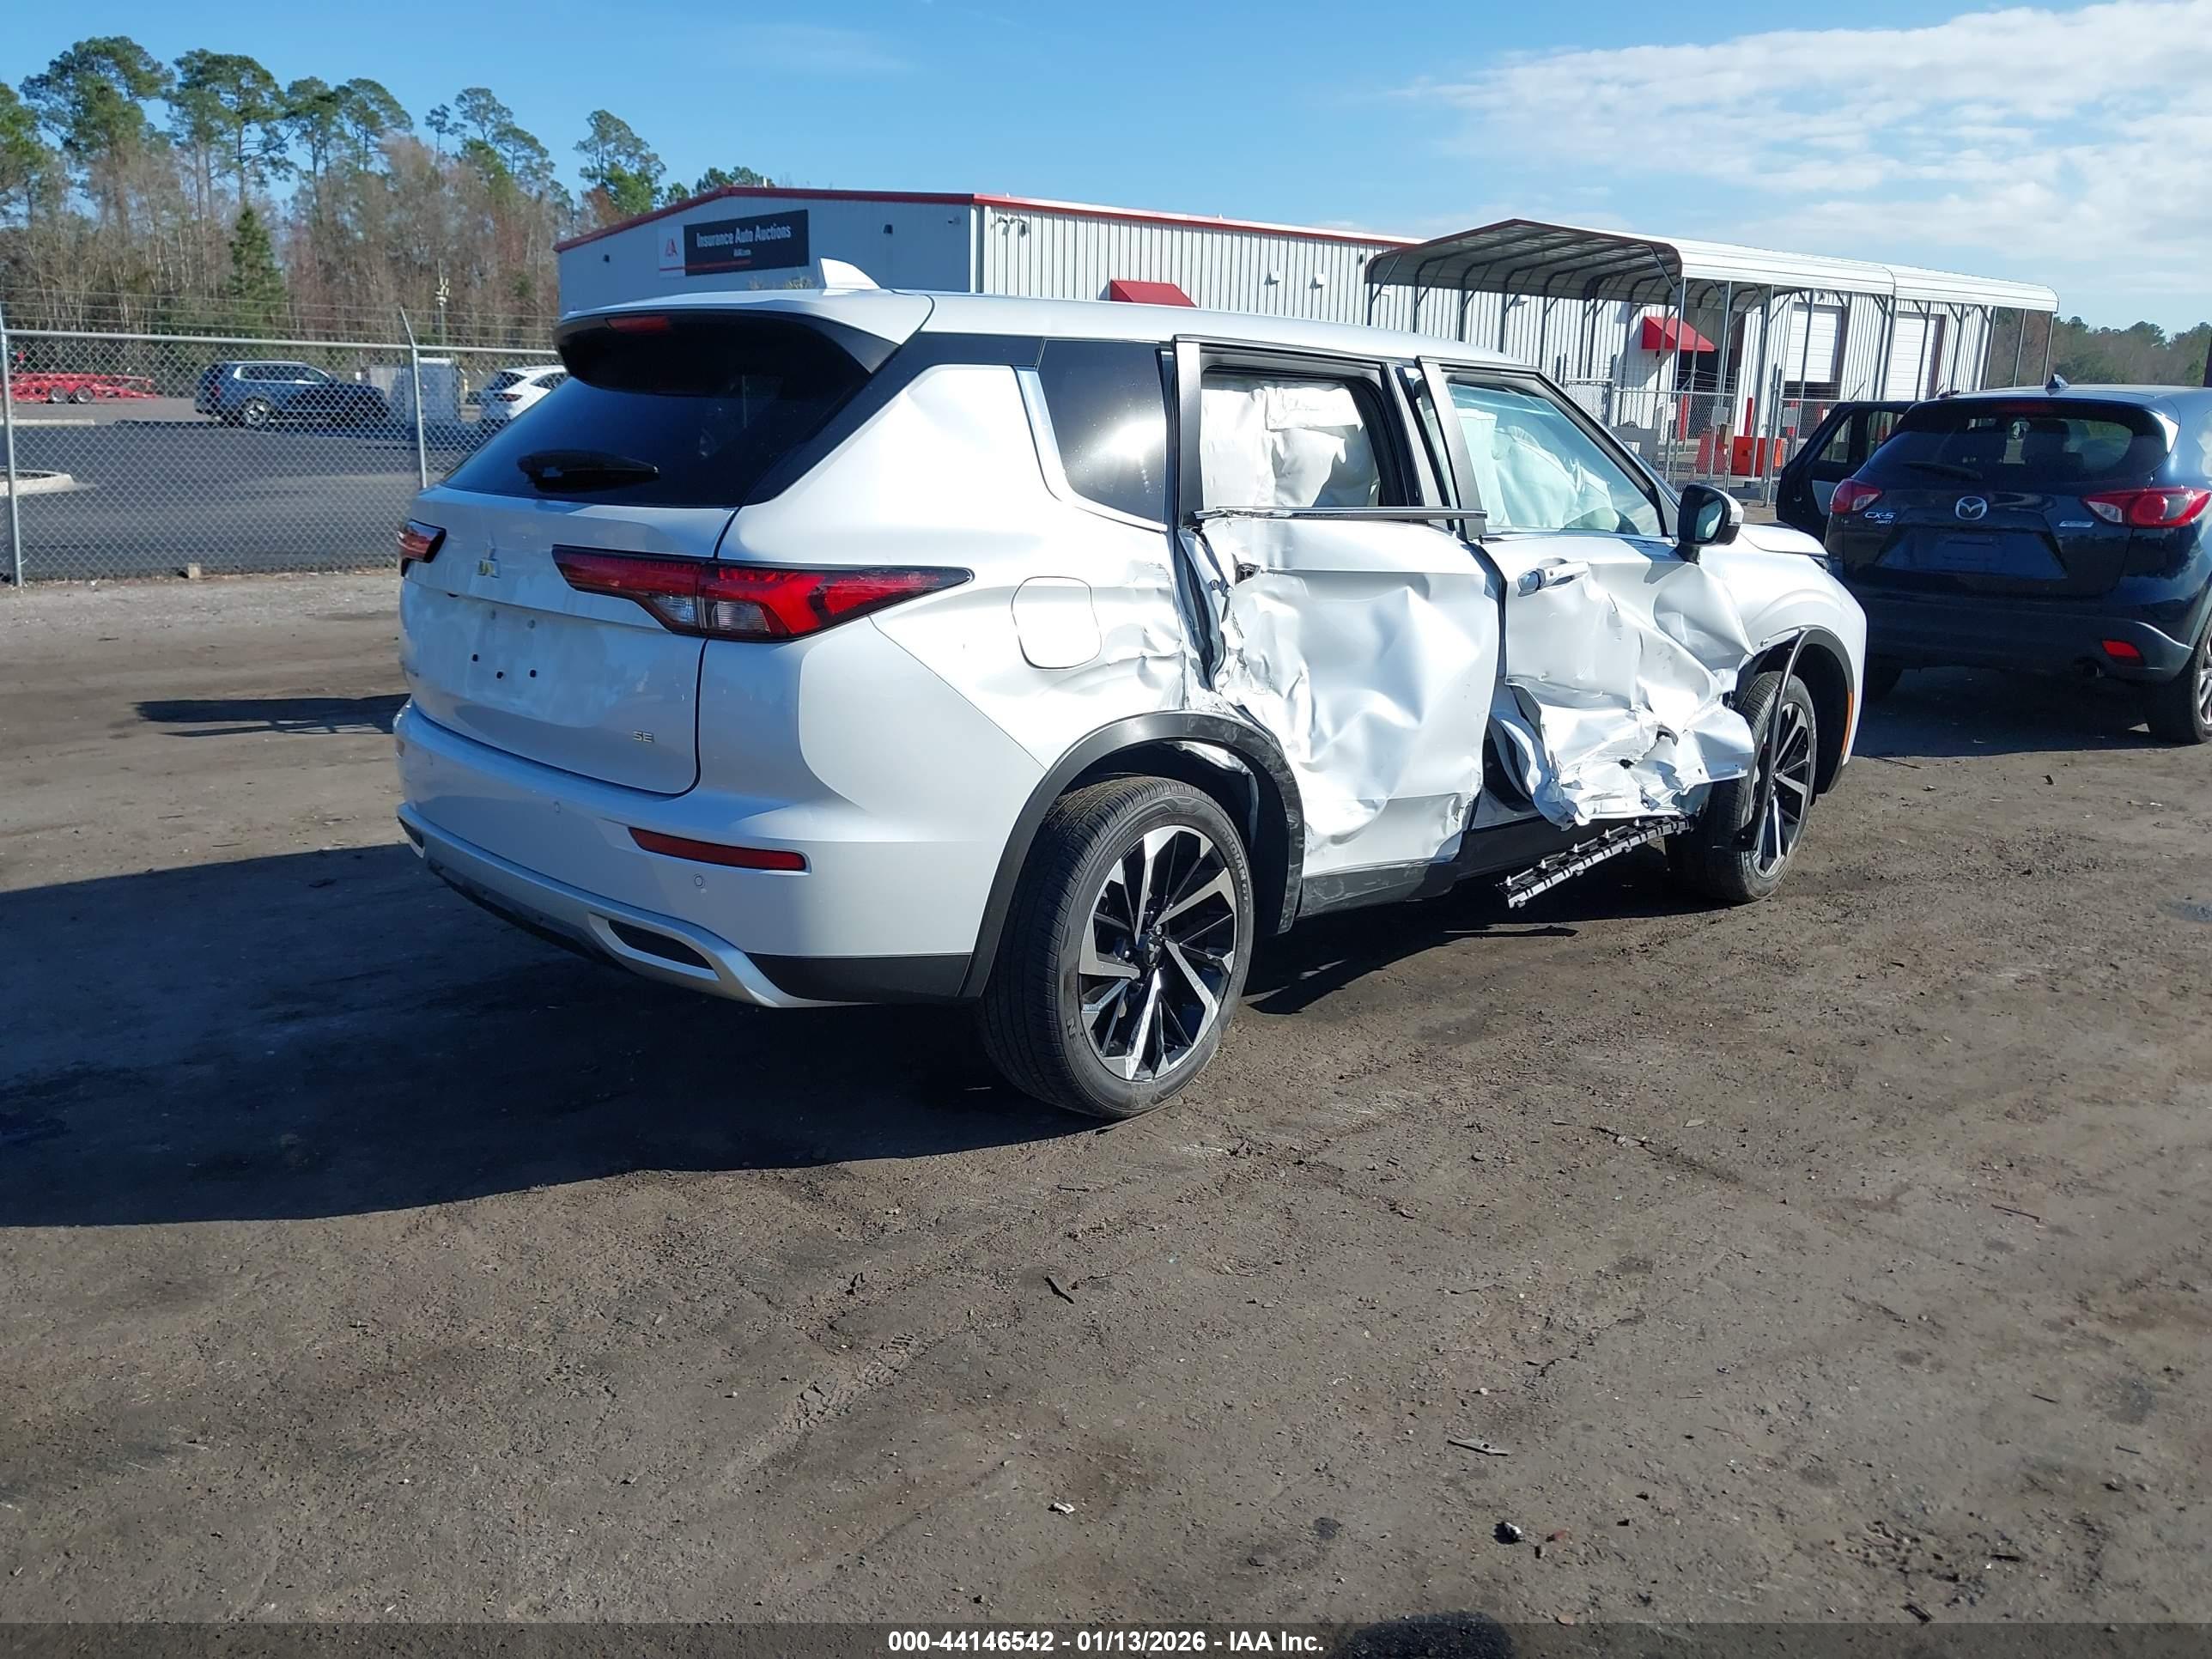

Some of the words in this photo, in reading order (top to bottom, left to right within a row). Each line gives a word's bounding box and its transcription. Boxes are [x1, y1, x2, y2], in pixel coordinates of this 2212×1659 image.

[696, 232, 734, 248] Insurance
[735, 227, 754, 244] Auto
[755, 222, 792, 241] Auctions
[633, 731, 653, 743] SE
